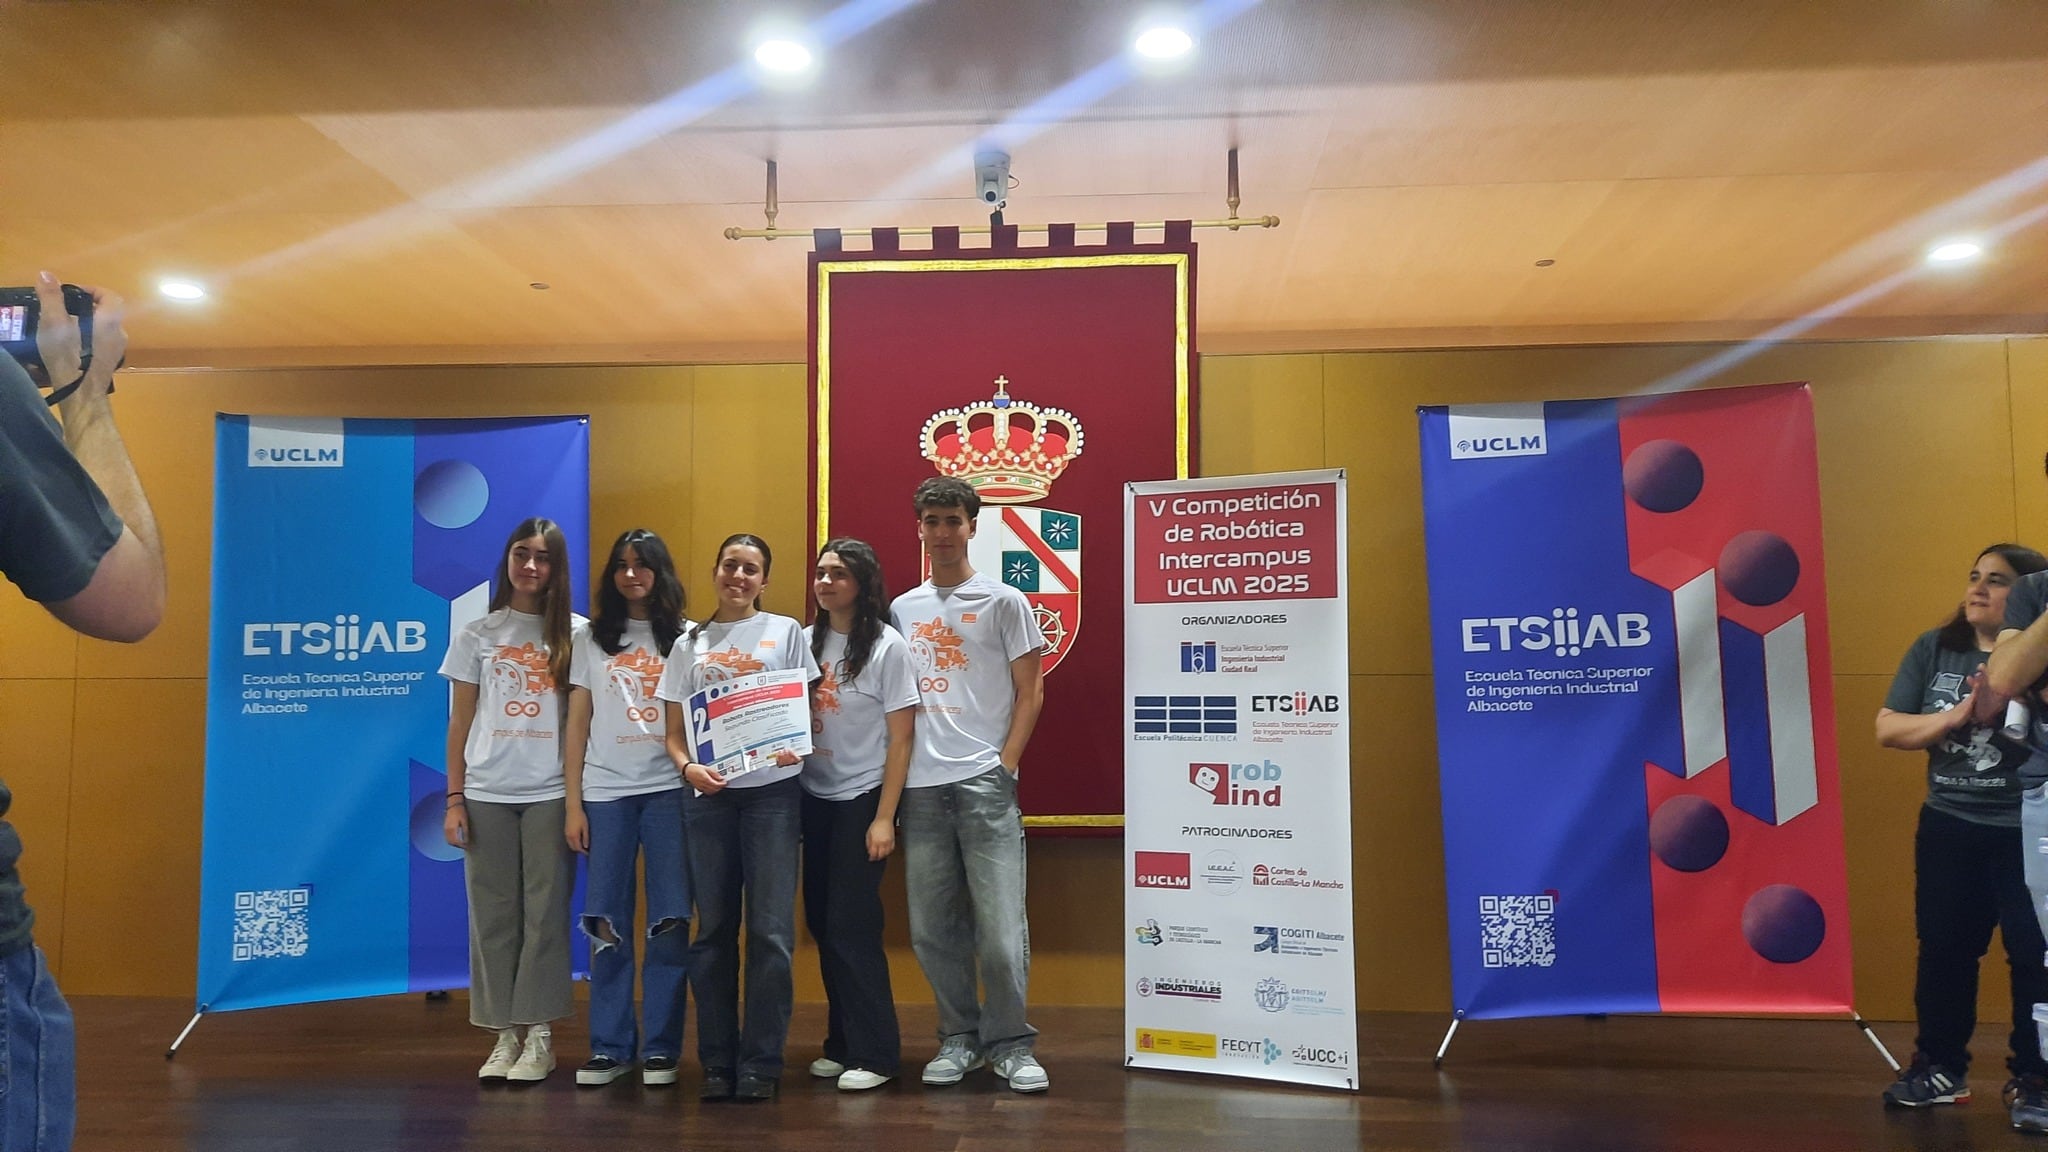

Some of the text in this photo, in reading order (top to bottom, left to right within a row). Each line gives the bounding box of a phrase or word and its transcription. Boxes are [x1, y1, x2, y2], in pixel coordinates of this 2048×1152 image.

[1472, 435, 1541, 452] UCLM
[270, 449, 338, 462] UCLM
[1149, 489, 1321, 518] V Competición
[1164, 519, 1304, 542] de Robótica
[1159, 549, 1311, 570] Intercampus
[1167, 574, 1310, 596] UCLM 2025
[1181, 614, 1287, 626] ORGANIZADORES
[243, 673, 301, 685] Escuela
[363, 671, 425, 685] Superior
[1465, 669, 1523, 682] Escuela
[1587, 667, 1654, 682] Superior
[242, 688, 261, 700] de
[342, 684, 410, 697] Industrial
[1466, 685, 1486, 697] de
[1567, 681, 1639, 695] Industrial
[242, 703, 308, 715] Albacete
[1467, 699, 1534, 712] Albacete
[1203, 734, 1238, 742] CUENCA
[1231, 759, 1282, 782] rob
[1231, 784, 1282, 806] ind
[1181, 826, 1293, 839] PATROCINADORES
[1270, 866, 1308, 876] Cortes de
[1147, 875, 1189, 887] UCLM
[1312, 880, 1344, 889] Mancha
[1281, 928, 1314, 939] COGITI
[1155, 983, 1222, 994] INDUSTRIALES
[1222, 1038, 1262, 1053] FECYT
